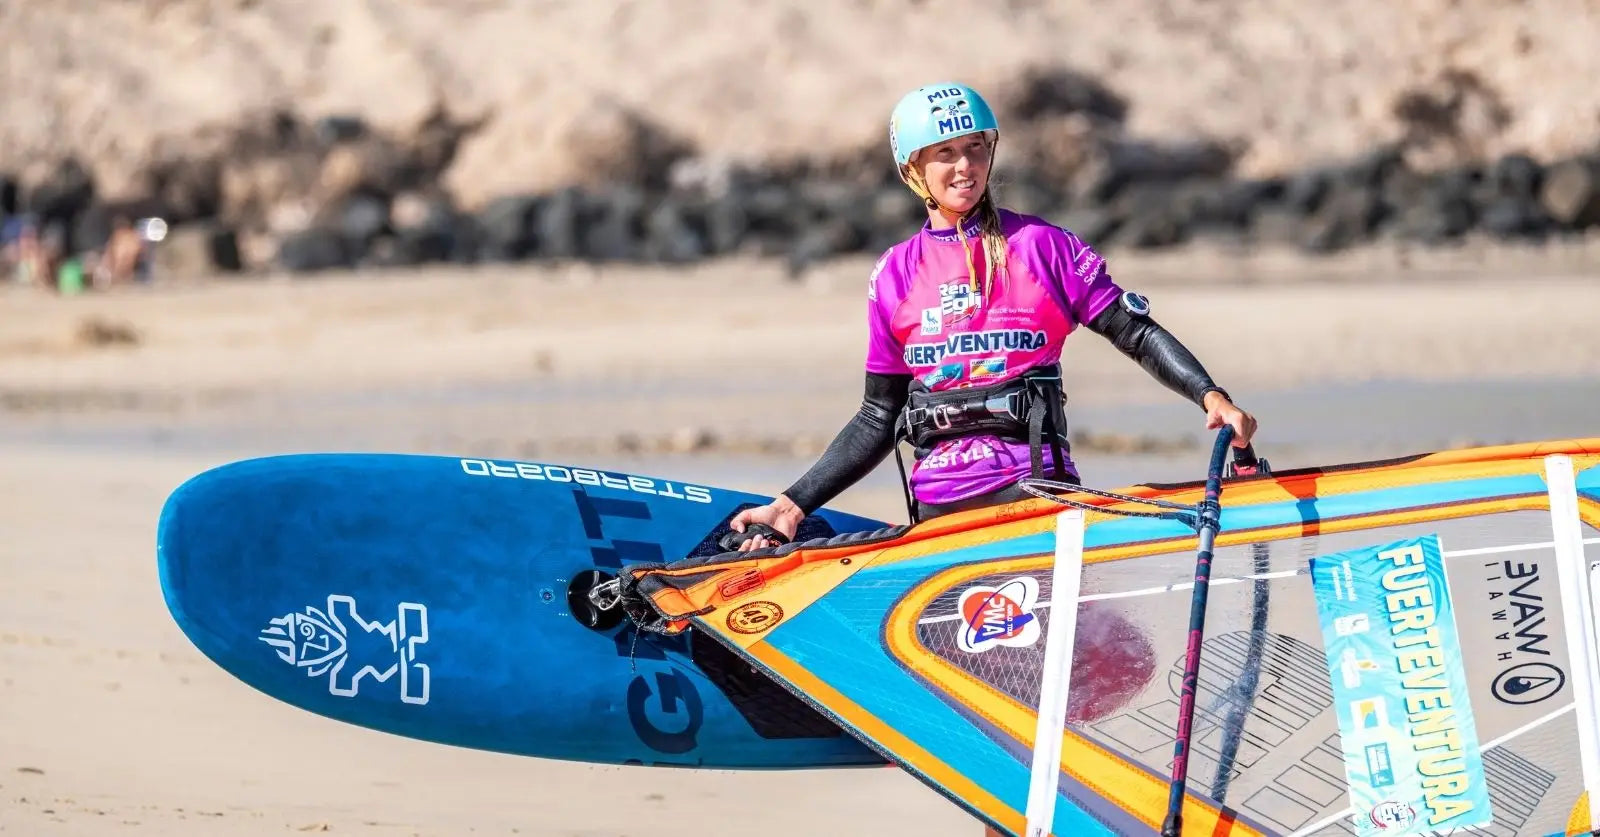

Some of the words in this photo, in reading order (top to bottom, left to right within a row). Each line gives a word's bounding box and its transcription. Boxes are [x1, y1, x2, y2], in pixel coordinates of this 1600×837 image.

[927, 88, 962, 103] MIO
[938, 115, 973, 134] MIO
[1074, 250, 1098, 277] World
[982, 597, 1006, 637] PWA
[1377, 543, 1474, 827] FUERTEVENTURA
